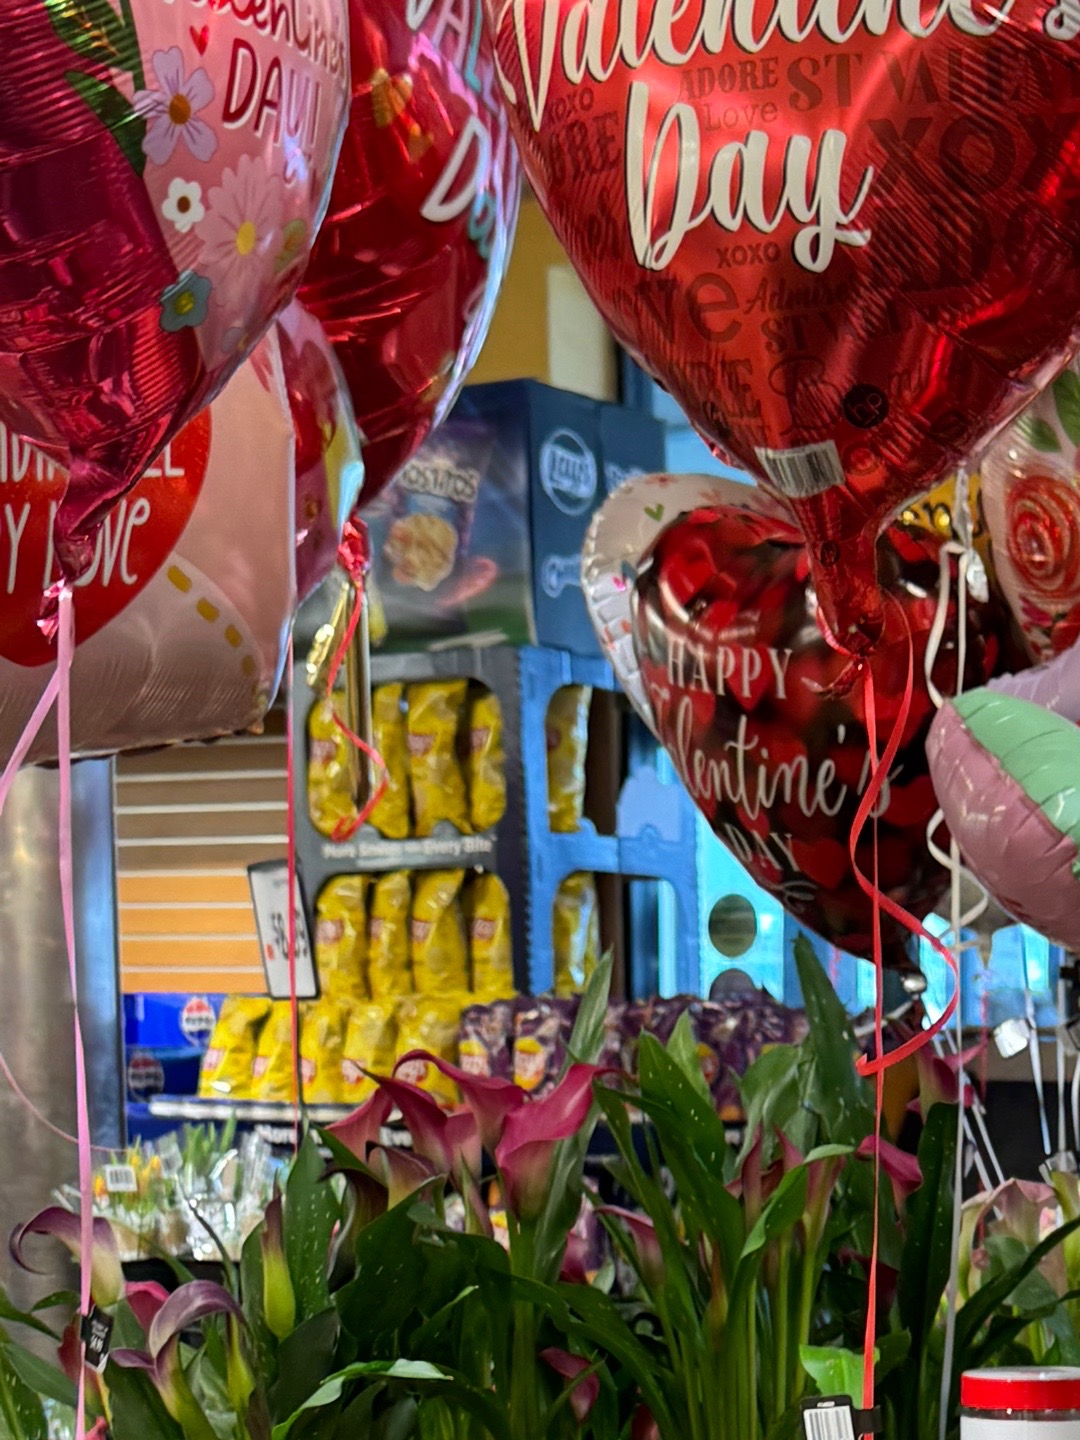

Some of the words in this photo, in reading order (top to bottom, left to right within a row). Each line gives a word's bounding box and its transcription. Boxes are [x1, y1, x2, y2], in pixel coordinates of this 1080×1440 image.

[677, 57, 780, 101] ADORE
[701, 101, 779, 131] Love
[625, 80, 875, 273] Day
[715, 241, 781, 269] XOXO
[667, 635, 793, 700] HAPPY
[723, 822, 801, 873] DAY
